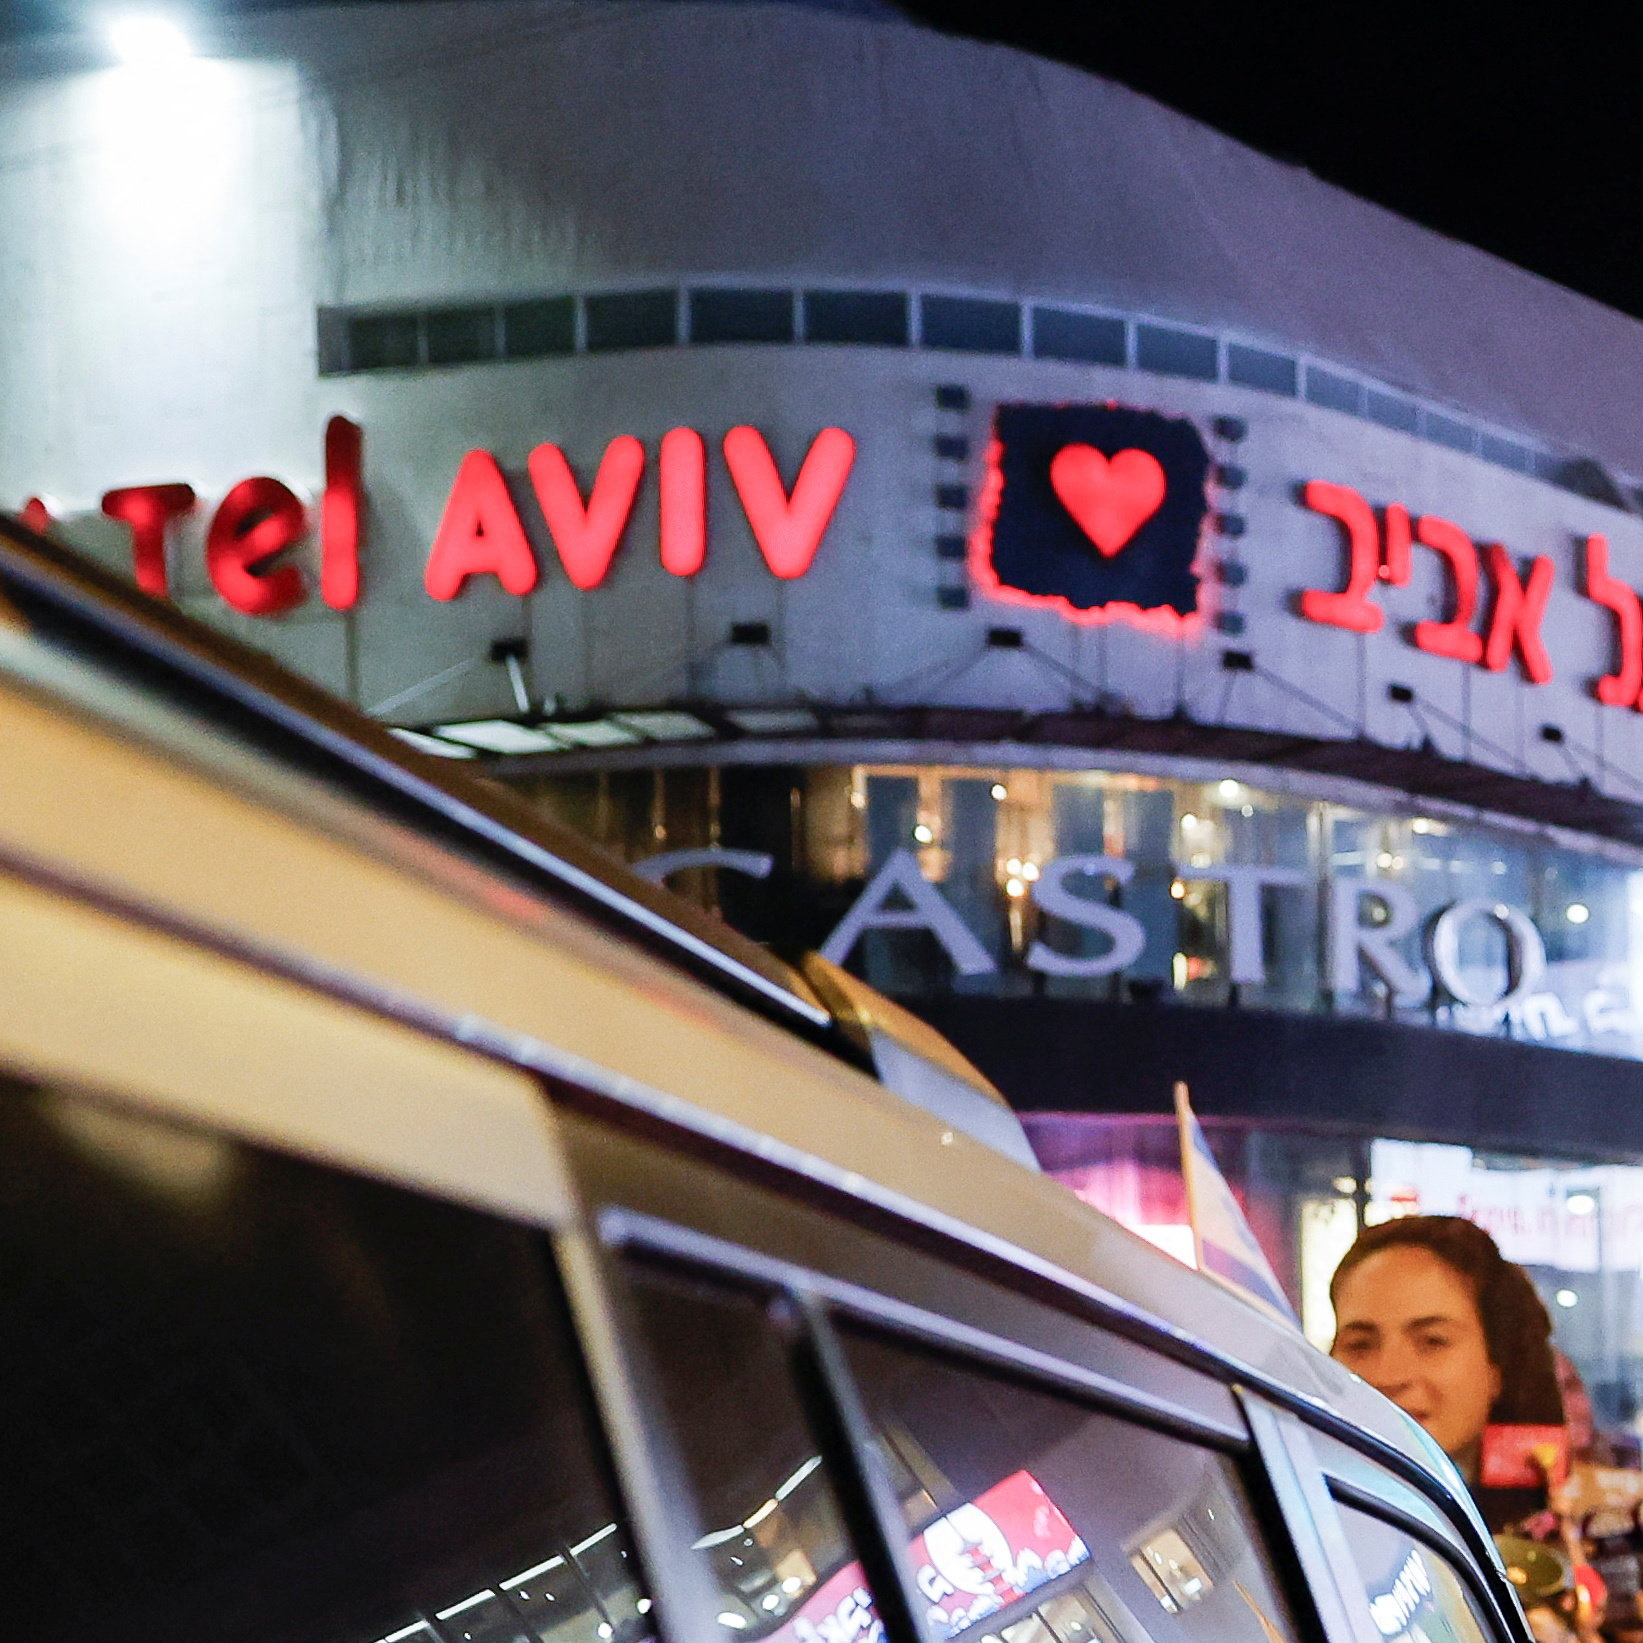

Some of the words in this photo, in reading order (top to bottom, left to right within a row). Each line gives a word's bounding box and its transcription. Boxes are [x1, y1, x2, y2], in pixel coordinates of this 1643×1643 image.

[101, 414, 364, 616] Tel
[424, 425, 856, 602] AVIV
[1299, 479, 1555, 686] אביב
[630, 848, 1546, 1008] ASTRO
